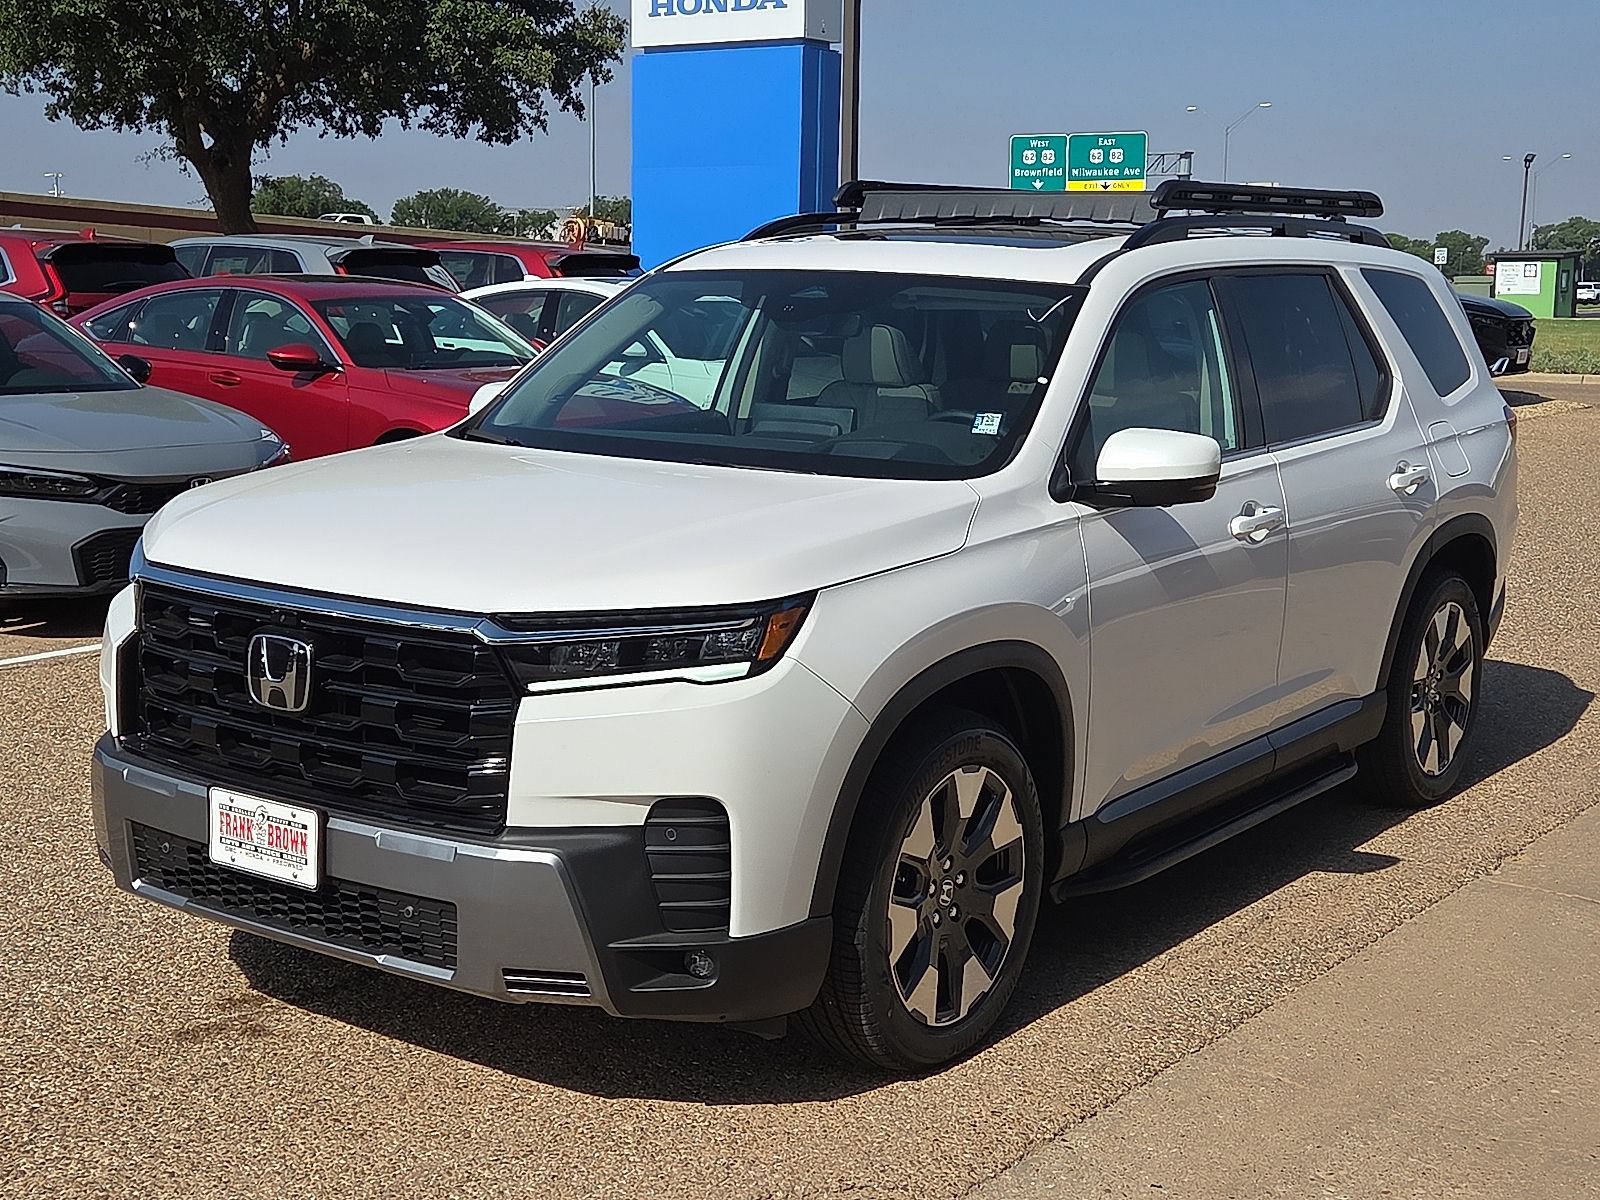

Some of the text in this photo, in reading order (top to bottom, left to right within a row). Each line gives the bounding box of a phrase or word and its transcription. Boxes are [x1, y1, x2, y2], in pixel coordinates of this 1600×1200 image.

[1030, 140, 1050, 148] WEST
[1098, 138, 1116, 146] EAST
[1024, 152, 1053, 160] 62 82
[1091, 152, 1122, 160] 62 82
[1014, 167, 1062, 177] Brownfield
[1071, 167, 1140, 176] Milwaukee Ave
[1436, 253, 1446, 262] 50
[219, 810, 254, 843] FRANK
[267, 823, 308, 857] BROWN
